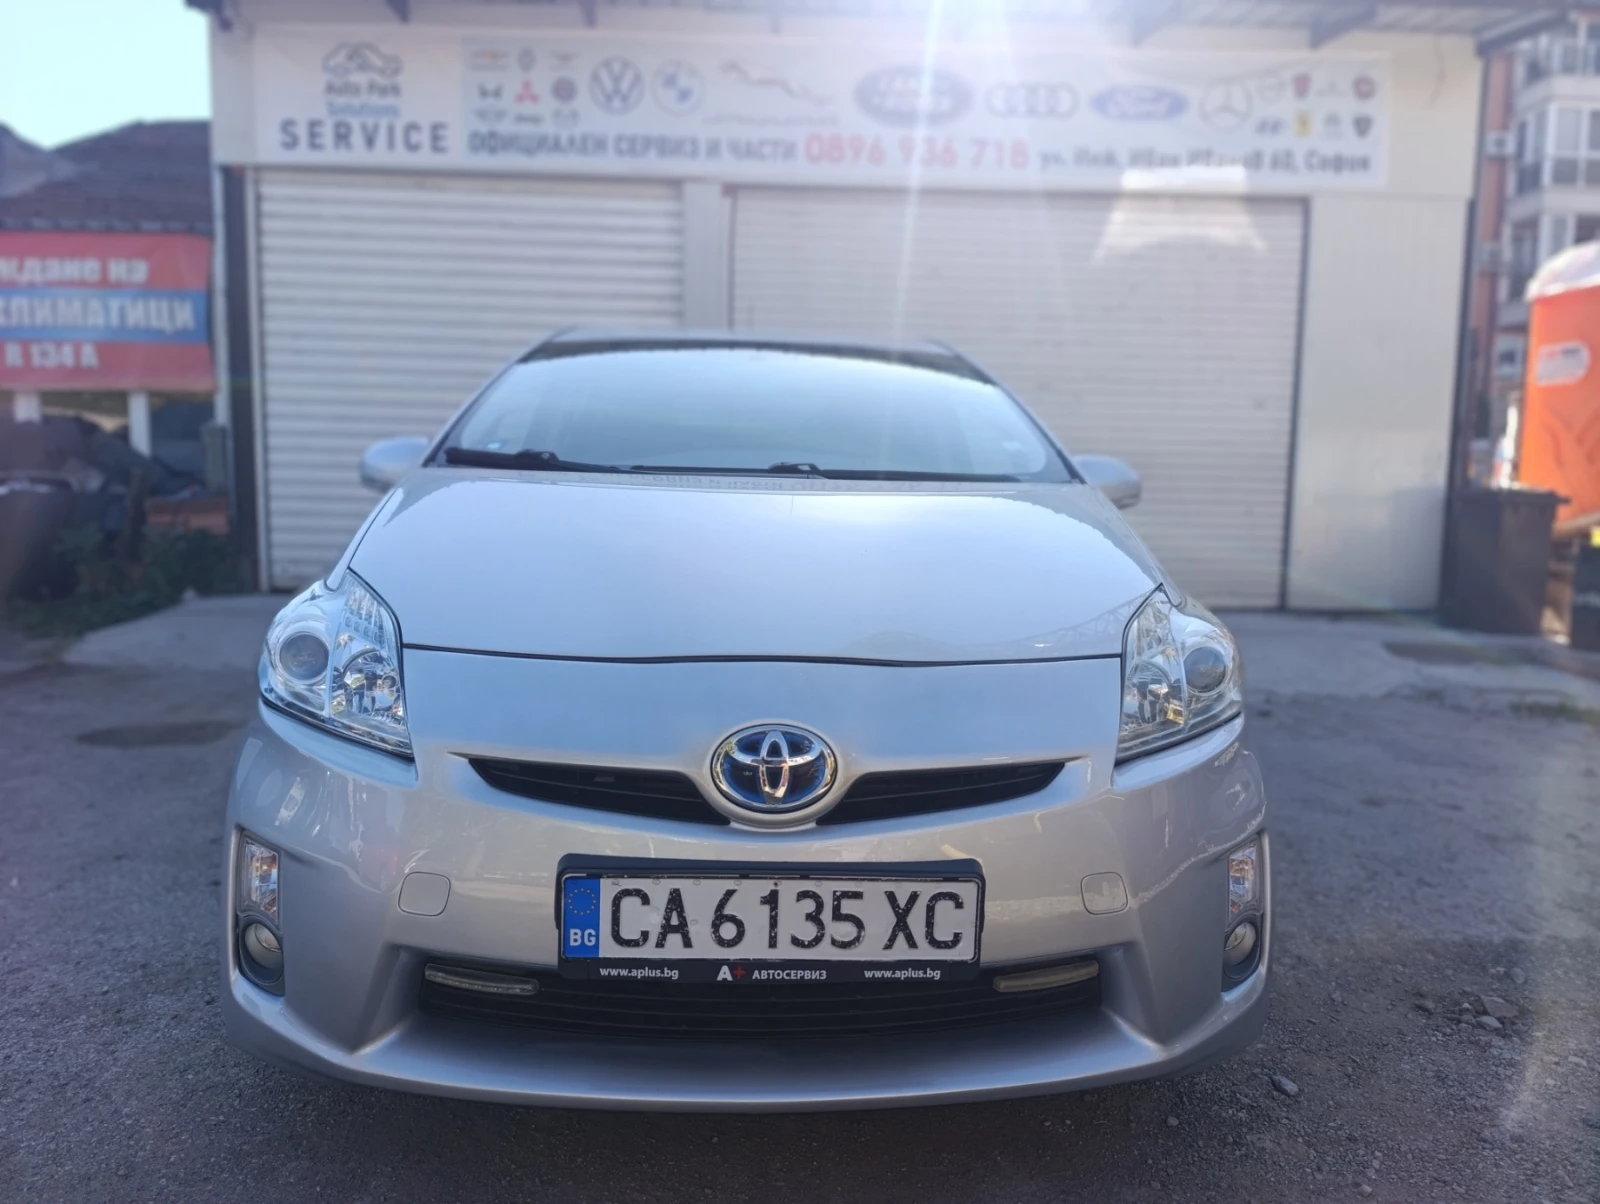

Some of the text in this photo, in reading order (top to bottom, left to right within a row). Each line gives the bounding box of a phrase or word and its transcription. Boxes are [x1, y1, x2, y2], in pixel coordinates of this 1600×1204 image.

[279, 118, 449, 152] SERVICE
[468, 129, 1030, 170] ОФИЦИАЛЕН СЕРВИЗ И ЧАСТИ 0896 936 718
[107, 256, 149, 285] на
[611, 887, 964, 951] CA 6135 XC
[569, 928, 596, 947] BG
[600, 967, 679, 981] www.aplus.bg
[752, 968, 827, 981] АВТОСЕРВИЗ
[864, 967, 941, 981] www.aplus.bg
